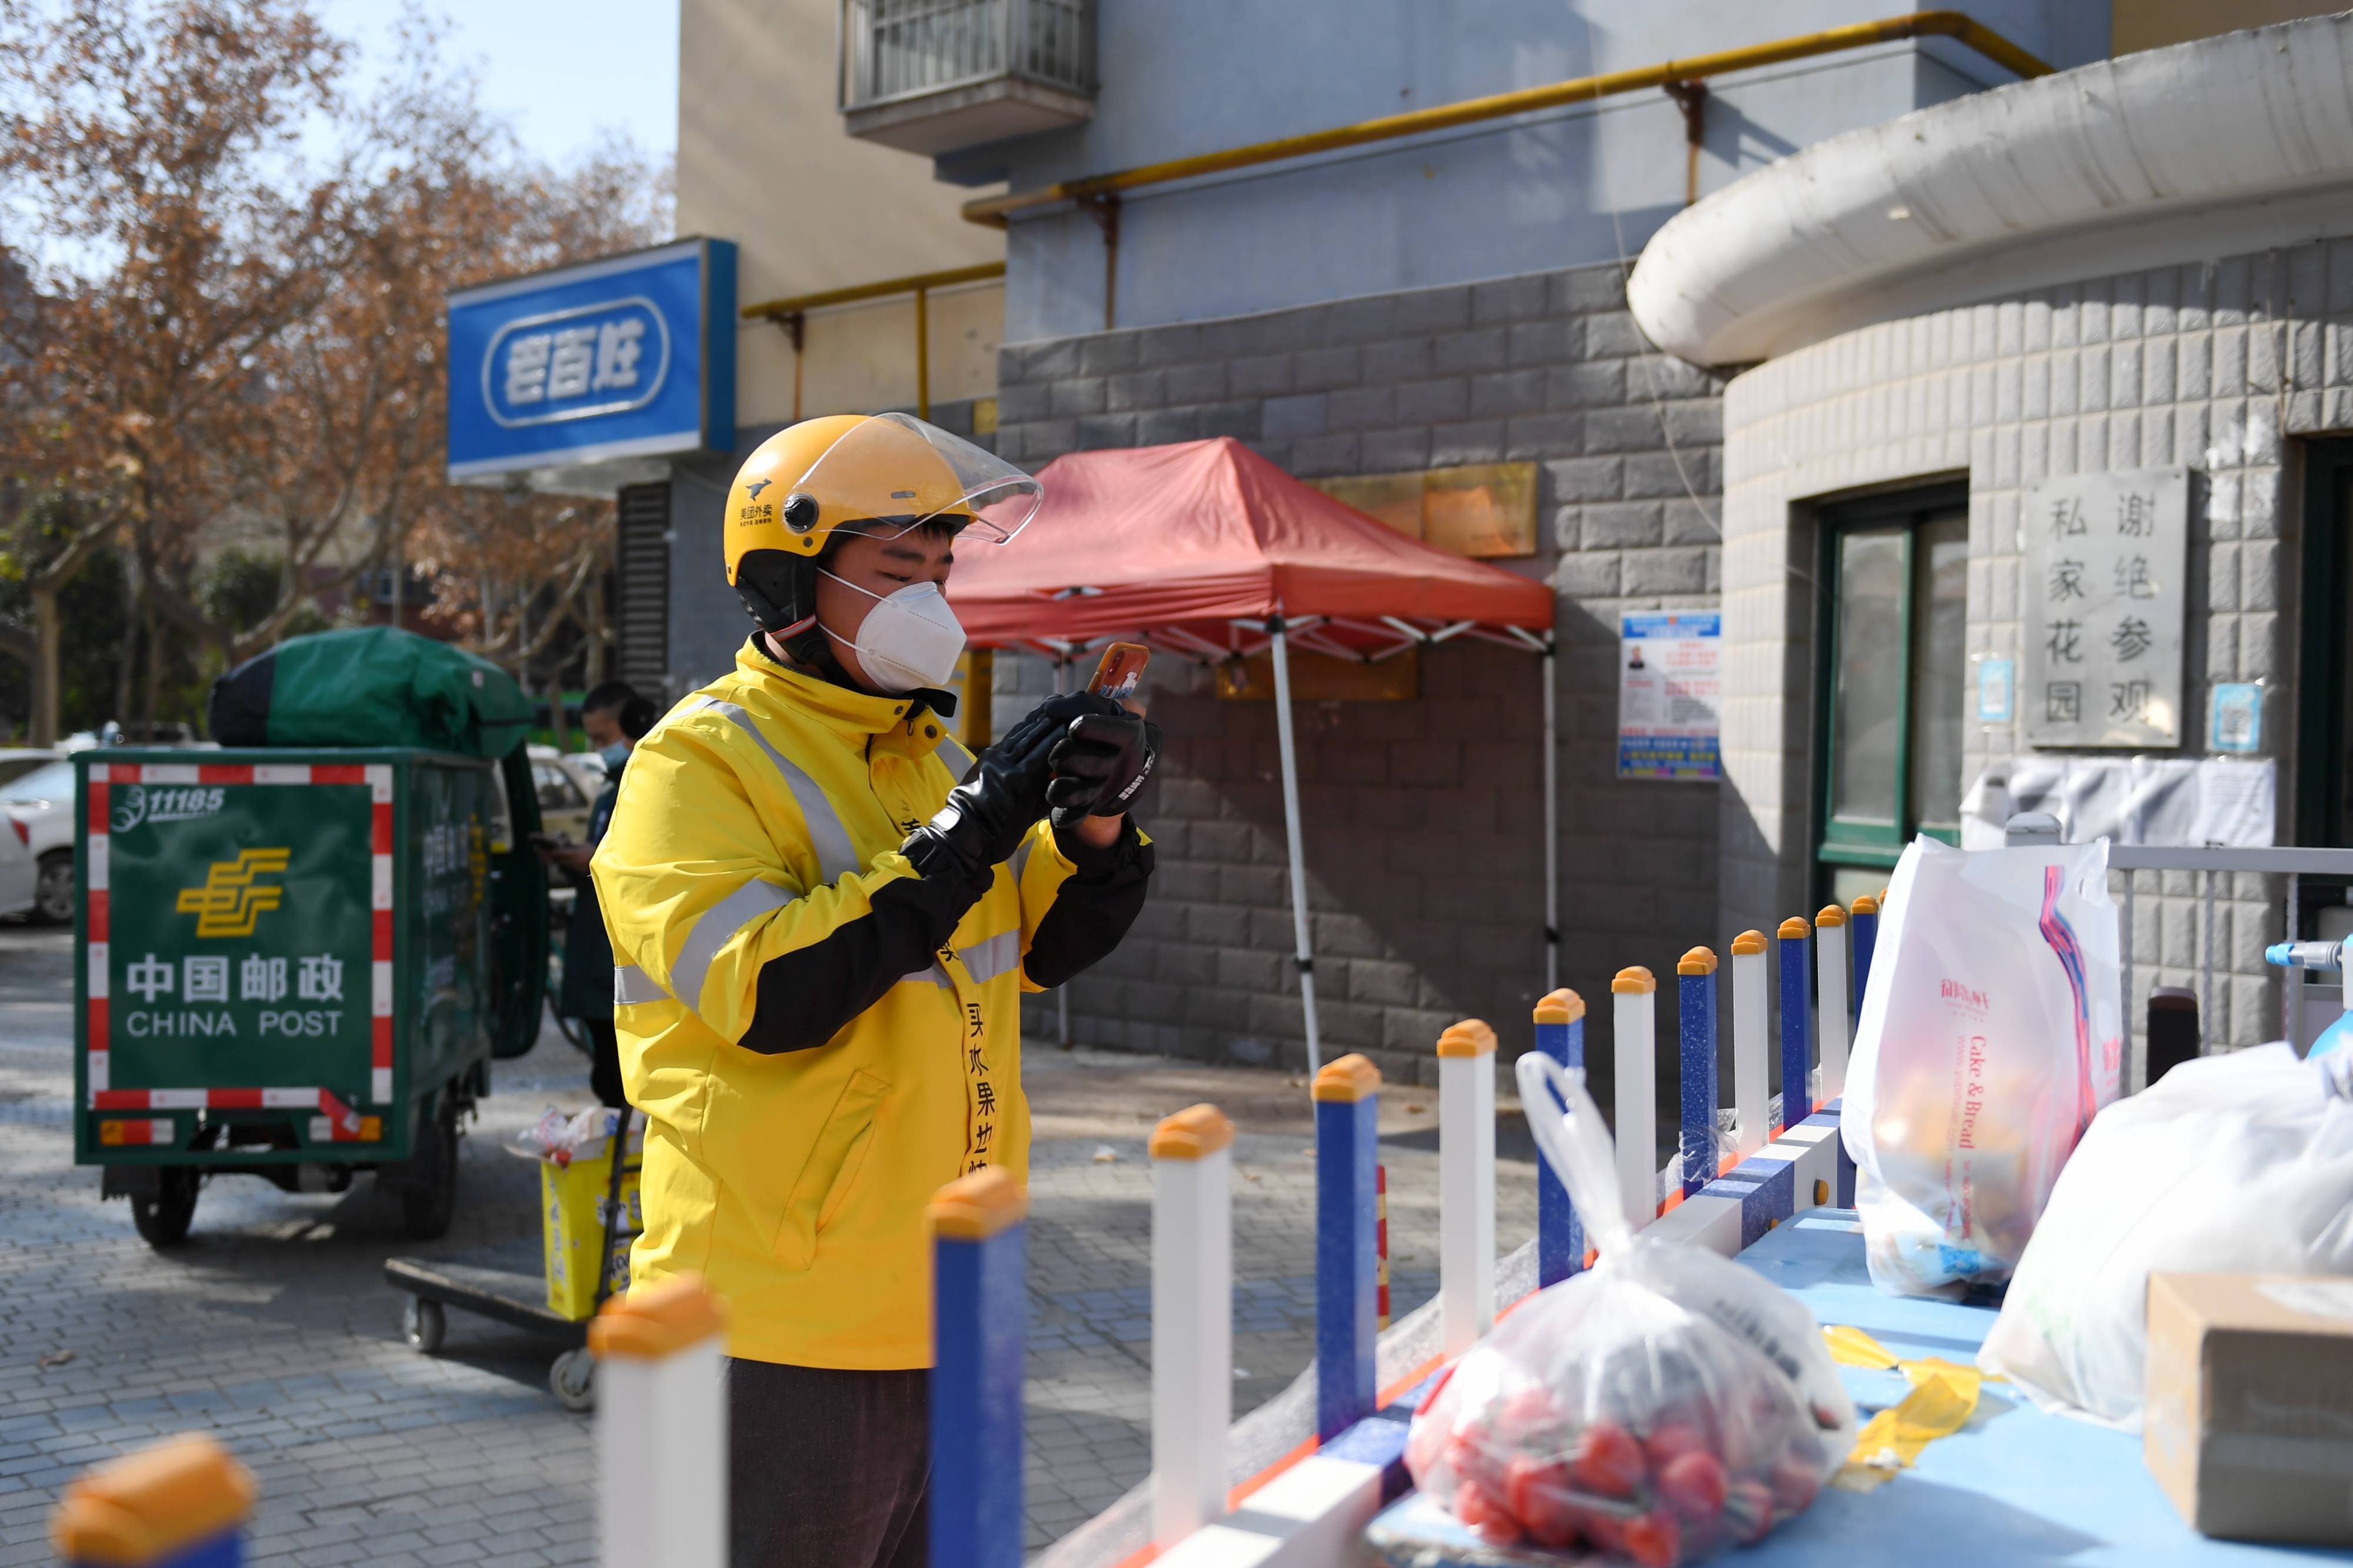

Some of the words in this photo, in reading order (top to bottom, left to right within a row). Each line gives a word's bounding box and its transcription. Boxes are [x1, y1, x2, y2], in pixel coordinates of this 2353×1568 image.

[741, 504, 772, 520] 美团外卖
[2046, 498, 2087, 723] 私家花园
[2109, 492, 2155, 724] 谢绝参观
[149, 788, 225, 813] 11185
[127, 953, 344, 1002] 中国邮政
[127, 1011, 237, 1036] CHINA
[260, 1010, 344, 1036] POST
[1969, 1036, 1987, 1077] Cake
[1968, 1083, 1984, 1096] &
[1959, 1102, 1982, 1149] Bread
